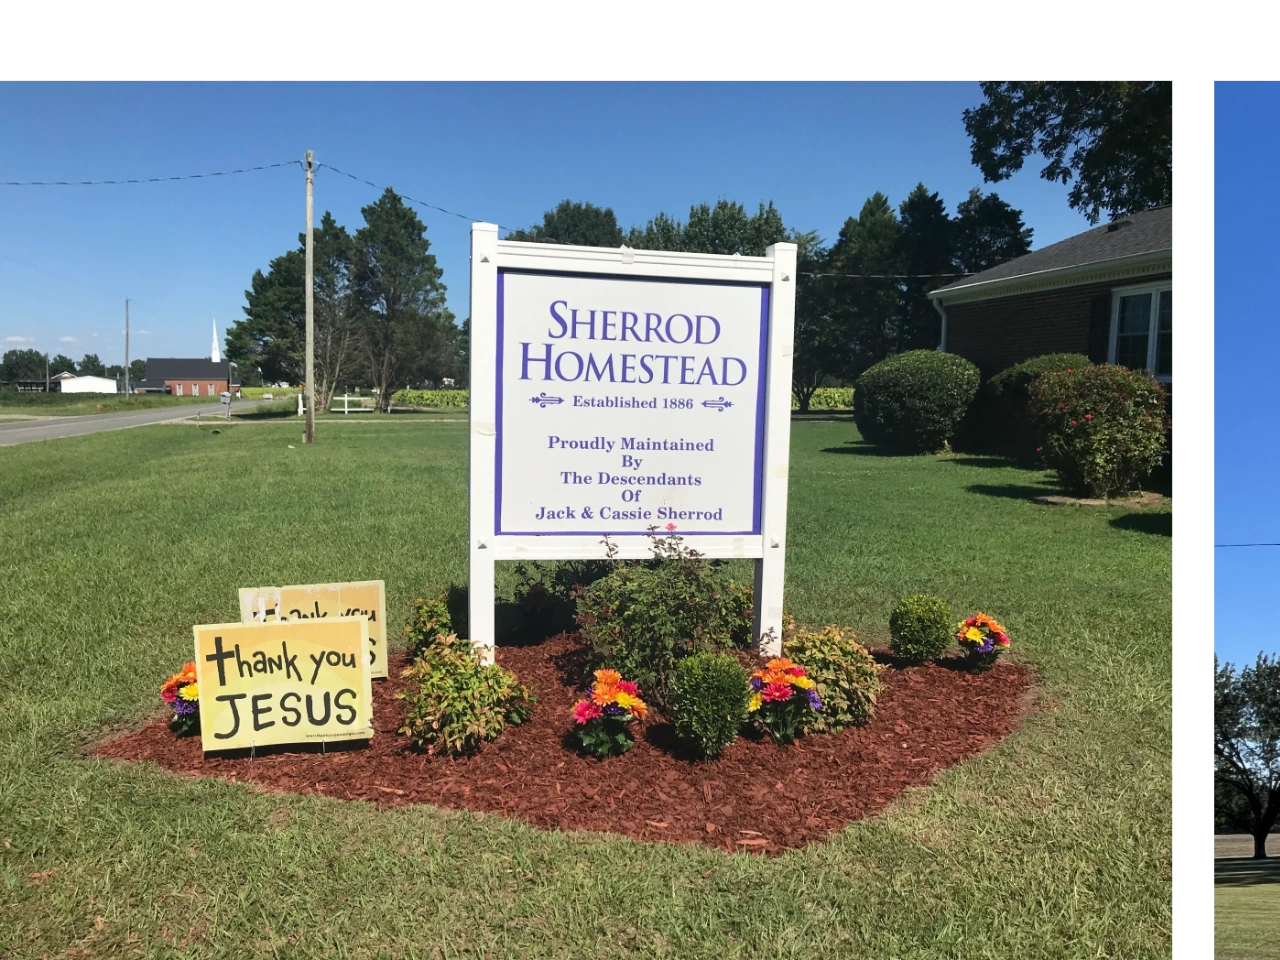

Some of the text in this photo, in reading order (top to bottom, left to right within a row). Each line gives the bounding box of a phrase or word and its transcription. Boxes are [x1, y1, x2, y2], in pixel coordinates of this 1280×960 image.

[547, 300, 721, 345] SHERROD
[518, 342, 748, 386] HOMESTEAD
[572, 395, 694, 410] Established 1886
[547, 435, 715, 453] Proudly Maintained
[621, 455, 643, 470] By
[560, 471, 702, 486] The Descendants
[621, 490, 642, 503] Of
[535, 506, 723, 521] Jack & Cassie Sherrod
[309, 650, 356, 685] you
[213, 688, 357, 740] JESUS
